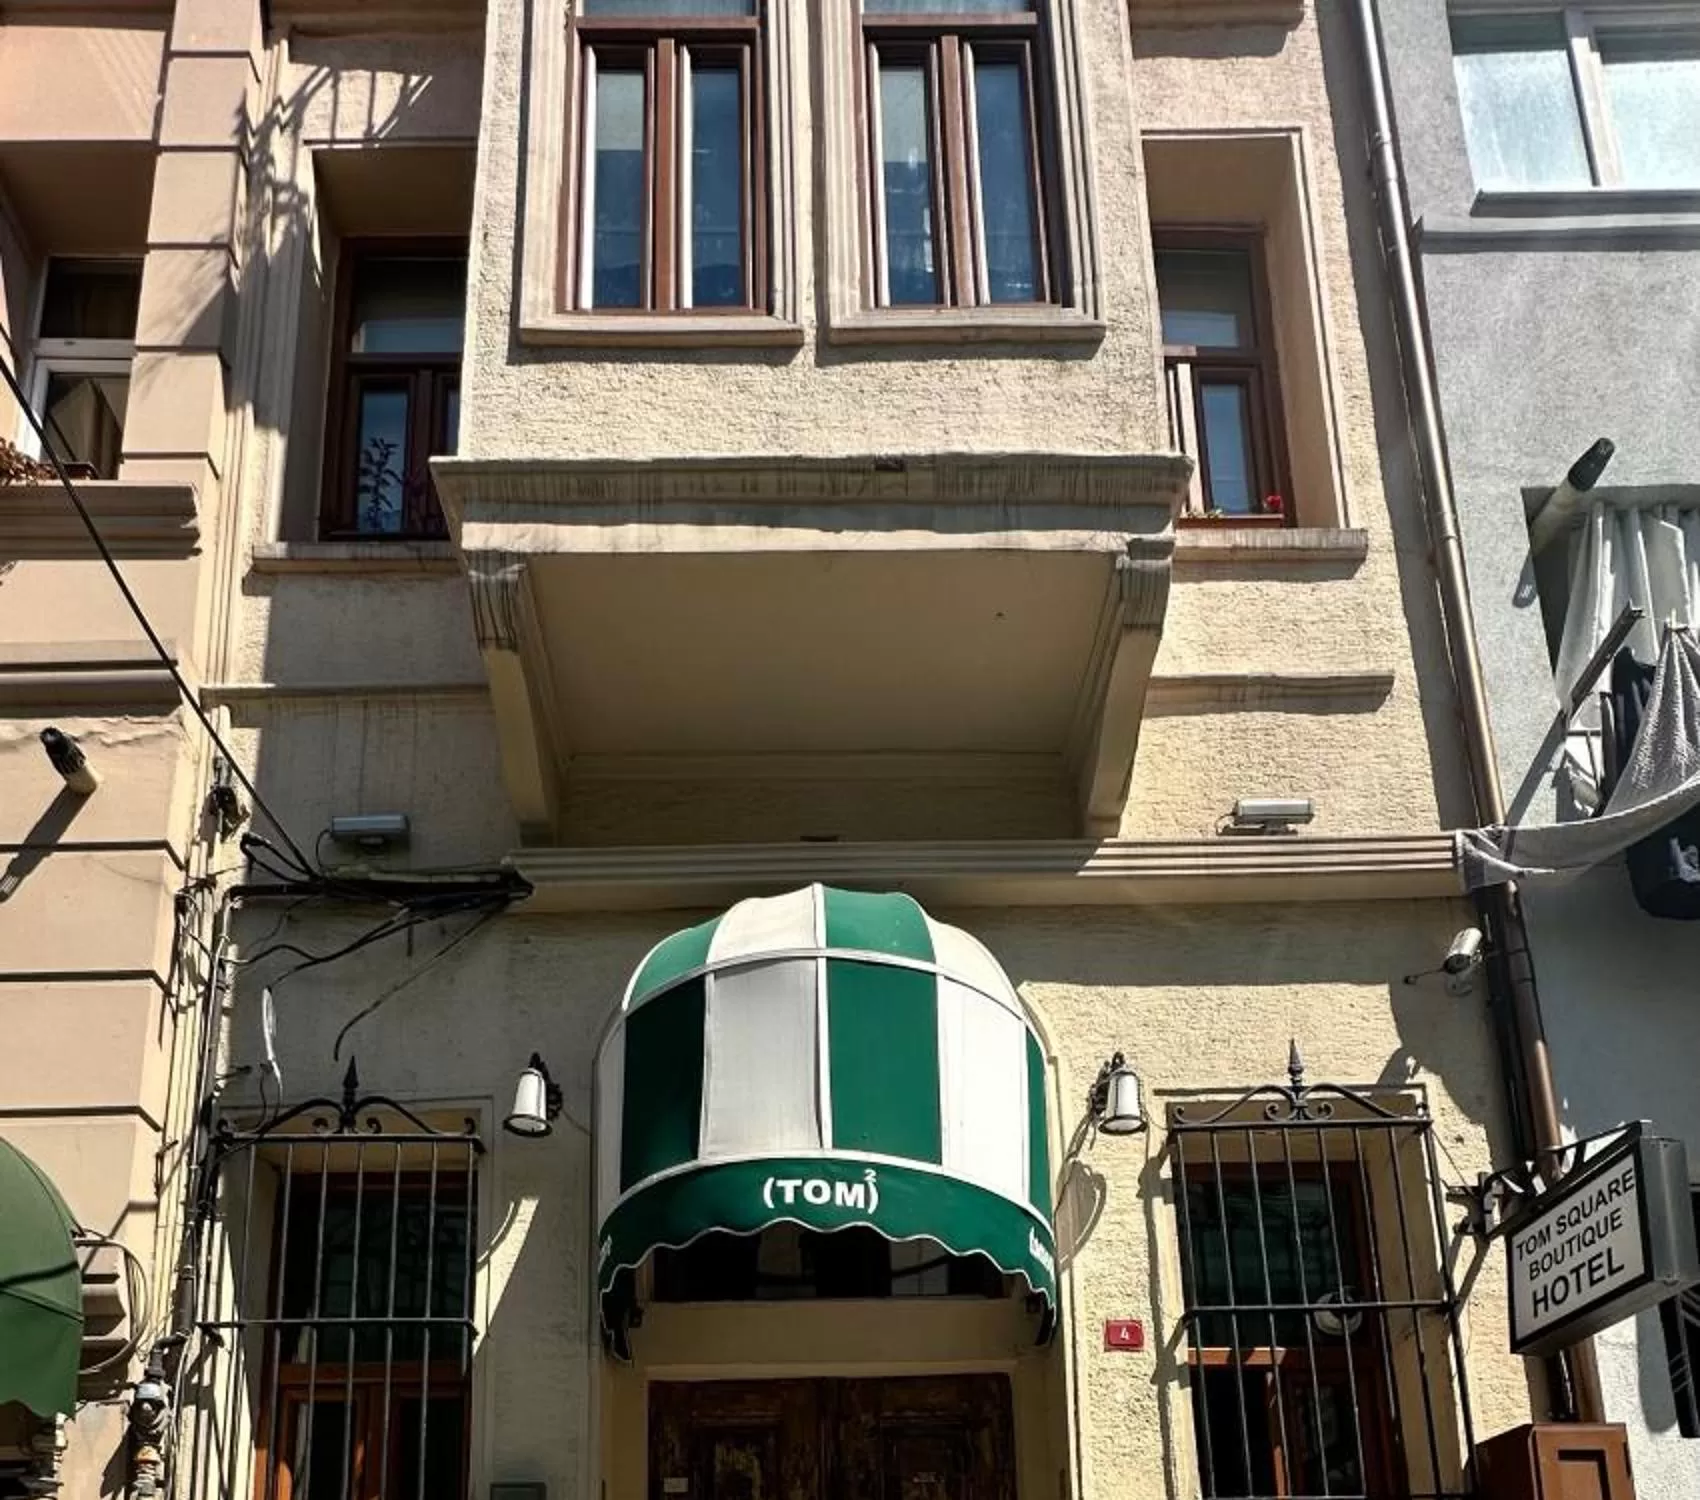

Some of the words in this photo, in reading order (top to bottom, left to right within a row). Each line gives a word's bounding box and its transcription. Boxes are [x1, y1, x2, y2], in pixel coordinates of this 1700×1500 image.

[1516, 1224, 1551, 1262] TOM
[1556, 1168, 1635, 1236] SQUARE
[1529, 1207, 1623, 1281] BOUTIQUE
[1532, 1247, 1625, 1318] HOTEL
